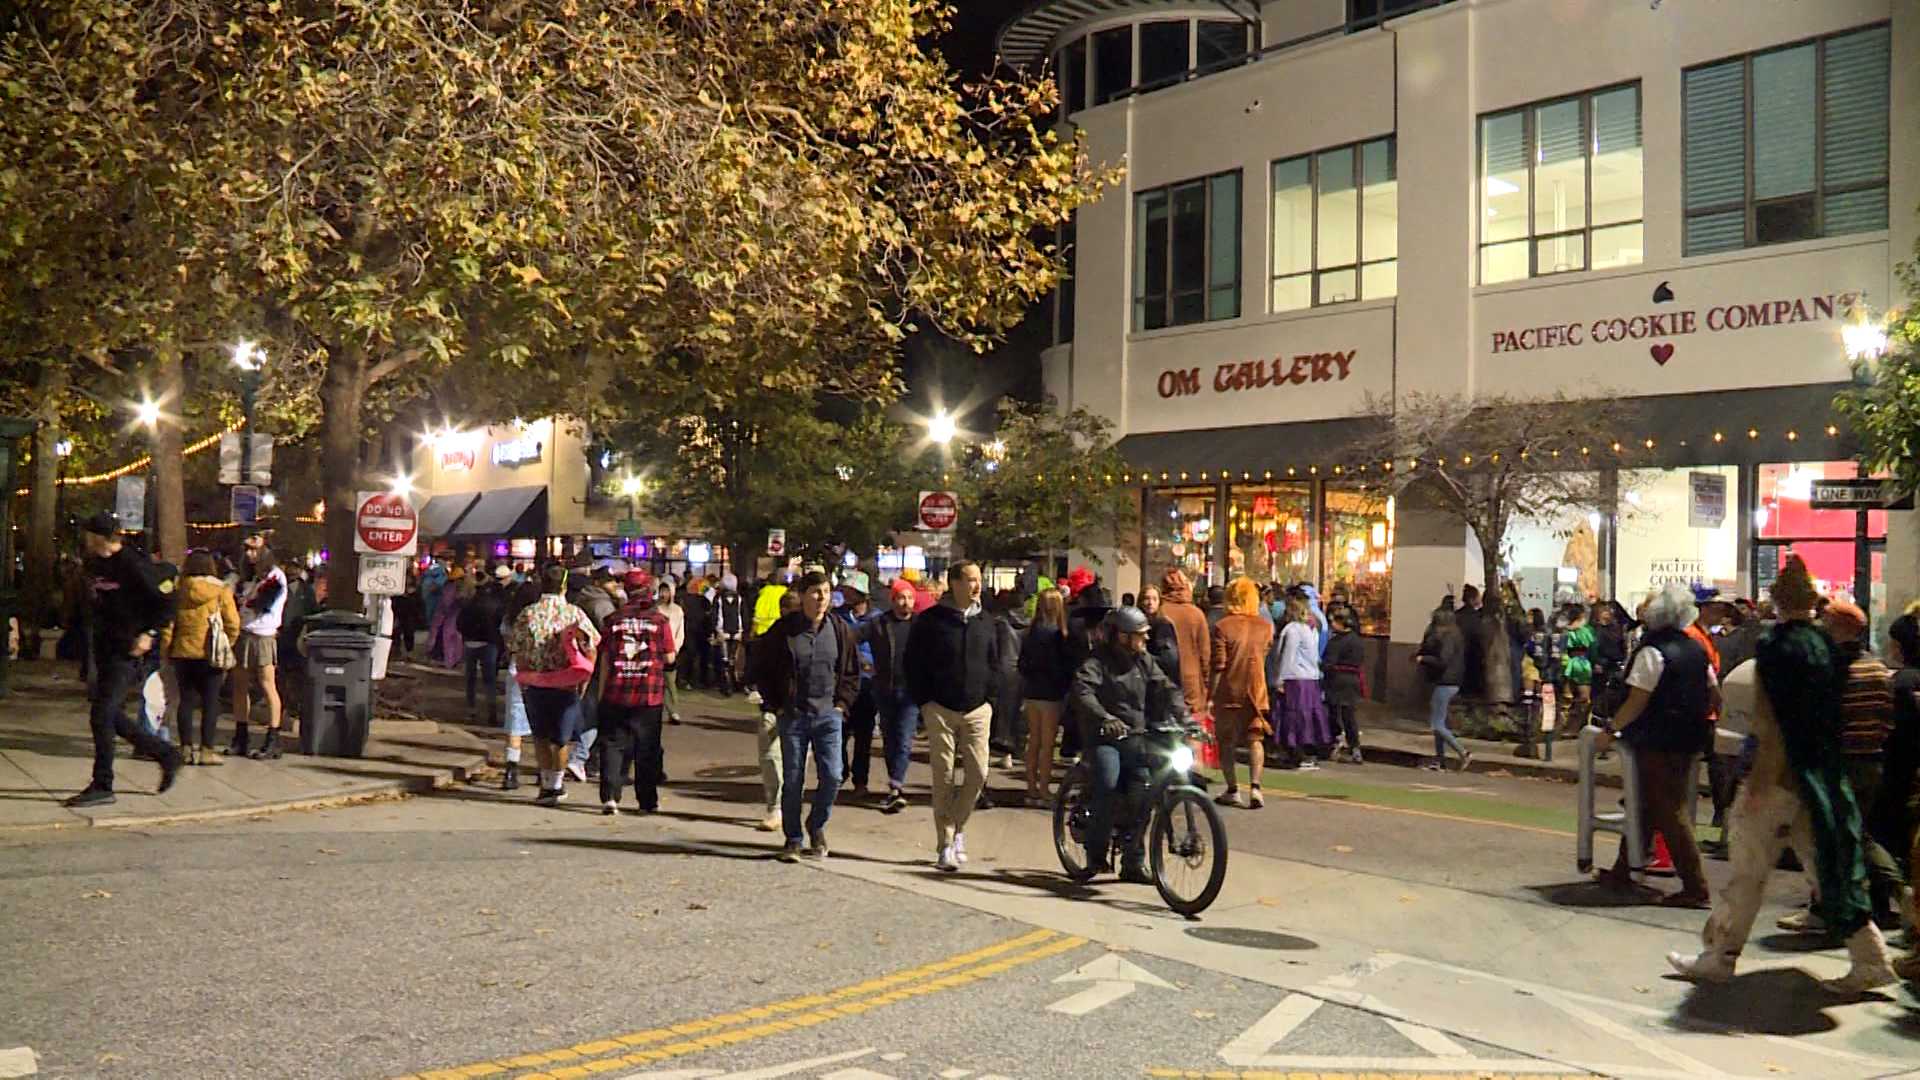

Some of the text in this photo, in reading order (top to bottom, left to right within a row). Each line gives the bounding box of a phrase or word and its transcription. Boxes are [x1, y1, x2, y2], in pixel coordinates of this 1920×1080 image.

[1491, 322, 1583, 354] PACIFIC
[1592, 311, 1696, 343] COOKIE
[1157, 349, 1356, 398] OM GALLERY
[1821, 486, 1880, 500] ONE WAY
[366, 503, 382, 514] DO
[368, 530, 403, 543] ENTER
[1650, 562, 1705, 573] PACIFIC
